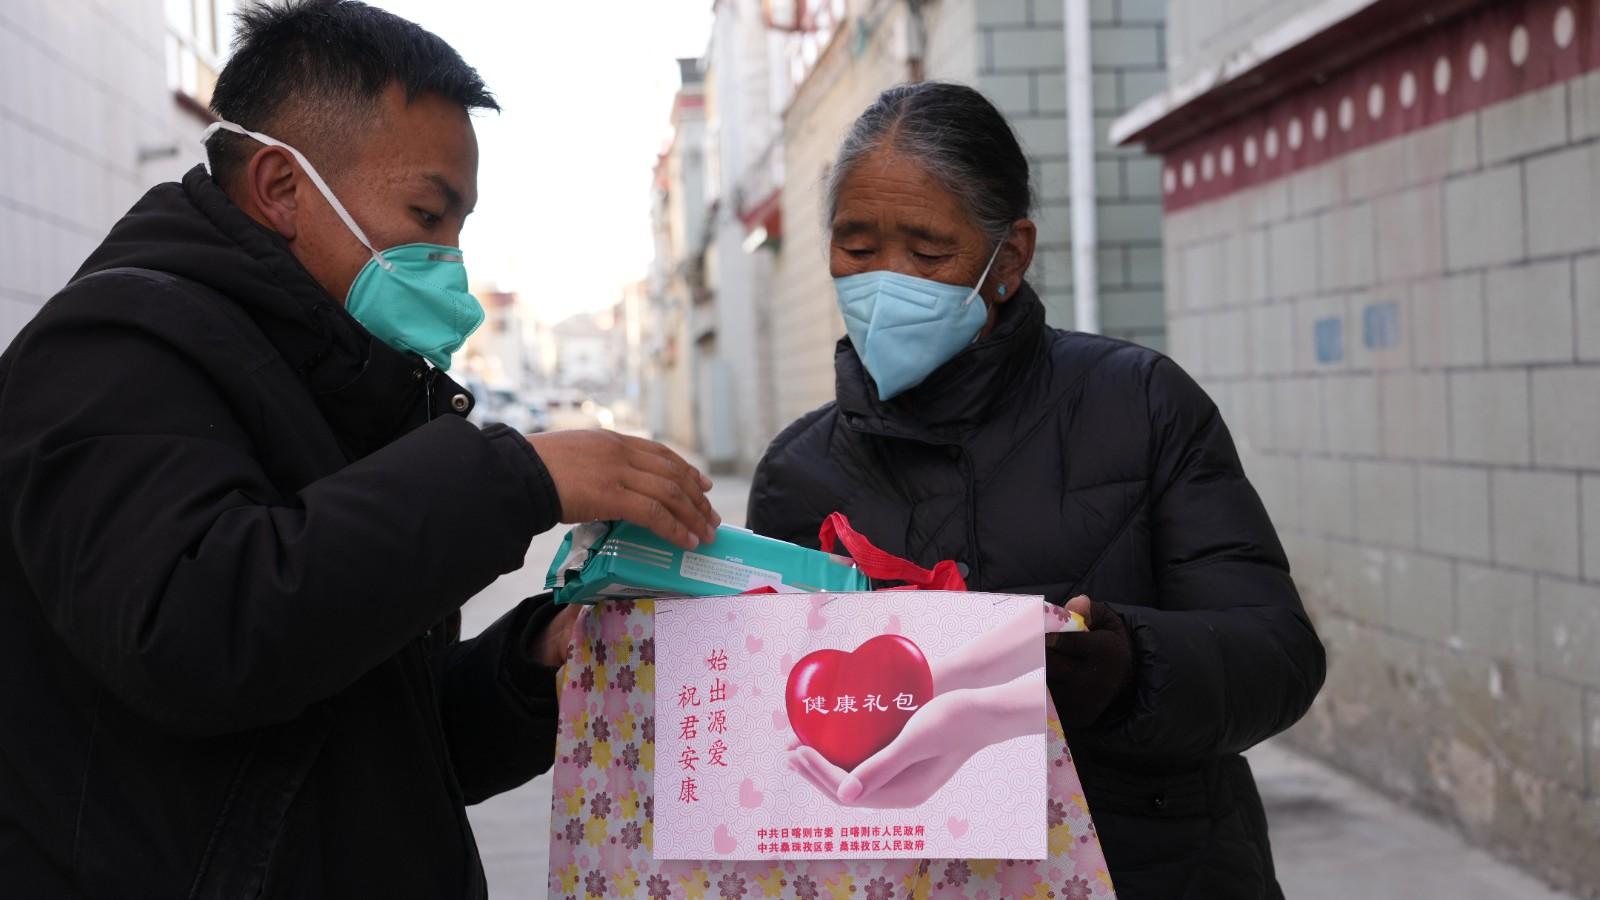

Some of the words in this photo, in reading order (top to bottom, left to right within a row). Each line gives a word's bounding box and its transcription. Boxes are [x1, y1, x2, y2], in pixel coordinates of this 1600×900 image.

[707, 648, 729, 768] 始出源爱
[801, 692, 919, 715] 健康礼包
[677, 685, 700, 804] 祝君安康
[757, 826, 834, 839] 中共日喀则市委
[840, 825, 925, 838] 日喀则市人民政府
